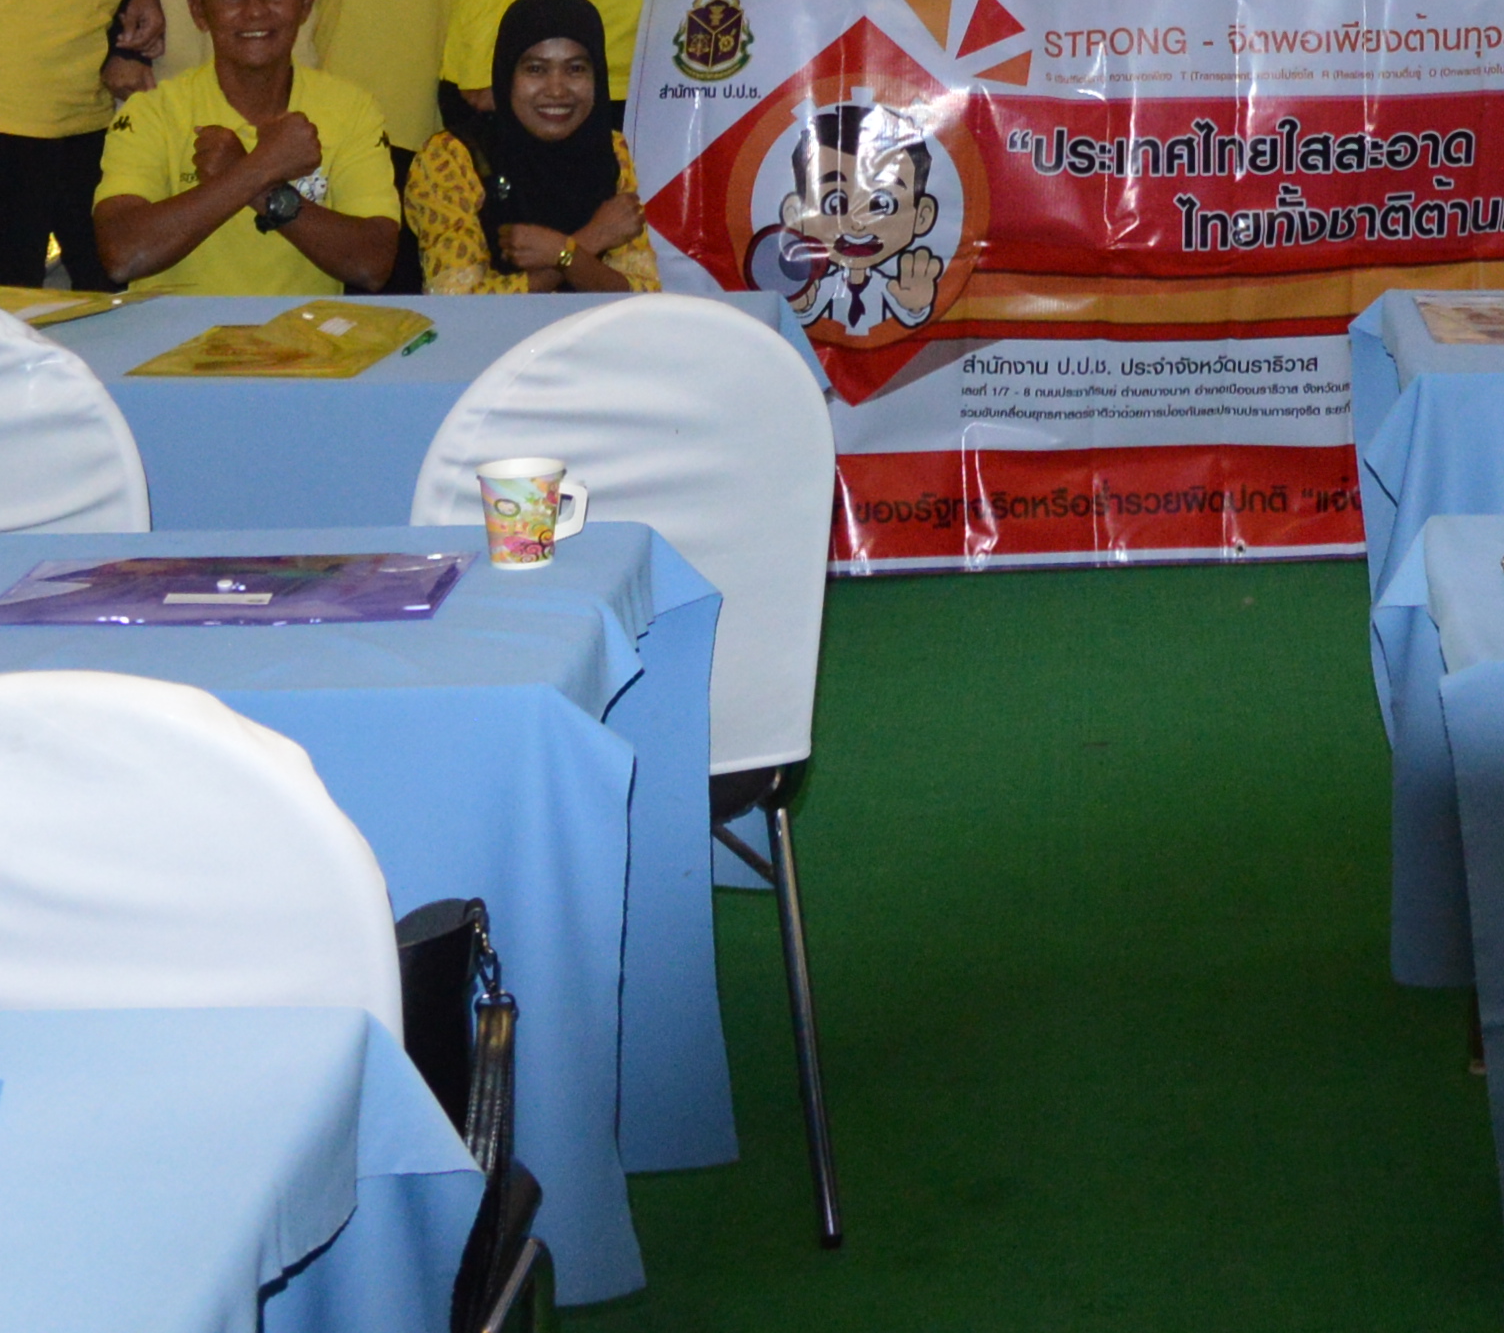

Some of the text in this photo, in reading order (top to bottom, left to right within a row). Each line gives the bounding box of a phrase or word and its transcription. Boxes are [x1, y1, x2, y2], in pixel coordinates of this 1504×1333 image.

[1044, 27, 1188, 58] STRONG
[1180, 71, 1188, 81] T
[1190, 71, 1252, 83] (Transparnt)
[1321, 69, 1330, 80] R
[1428, 68, 1437, 78] O
[1007, 118, 1475, 177] “ประเทศไทยใสสะอาด
[962, 353, 1319, 377] สำนักงาน ป.ป.ช. ประจำจังหวัดนราธิวาส
